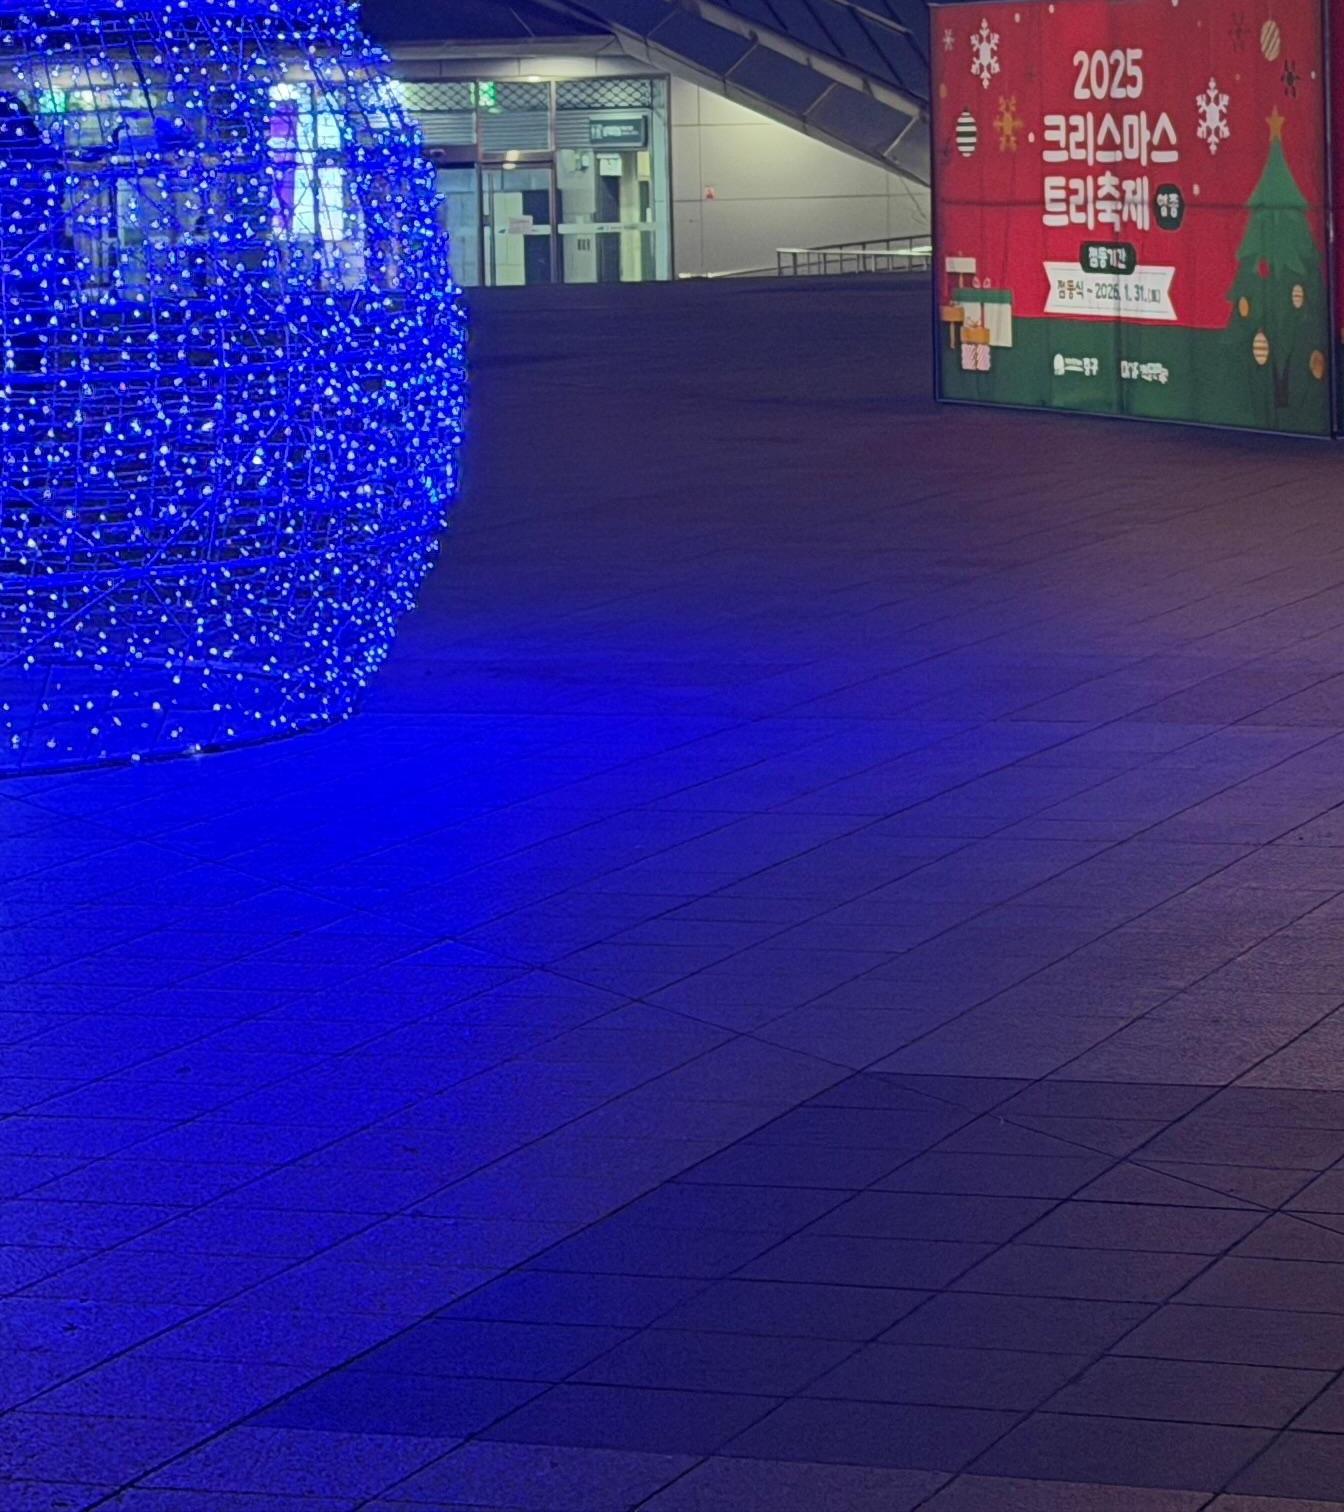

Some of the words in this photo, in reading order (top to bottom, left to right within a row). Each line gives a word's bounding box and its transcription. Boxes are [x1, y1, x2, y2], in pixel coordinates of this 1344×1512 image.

[1072, 48, 1144, 100] 2025
[1042, 110, 1179, 167] 크리스마스
[1042, 170, 1151, 232] 트리축제
